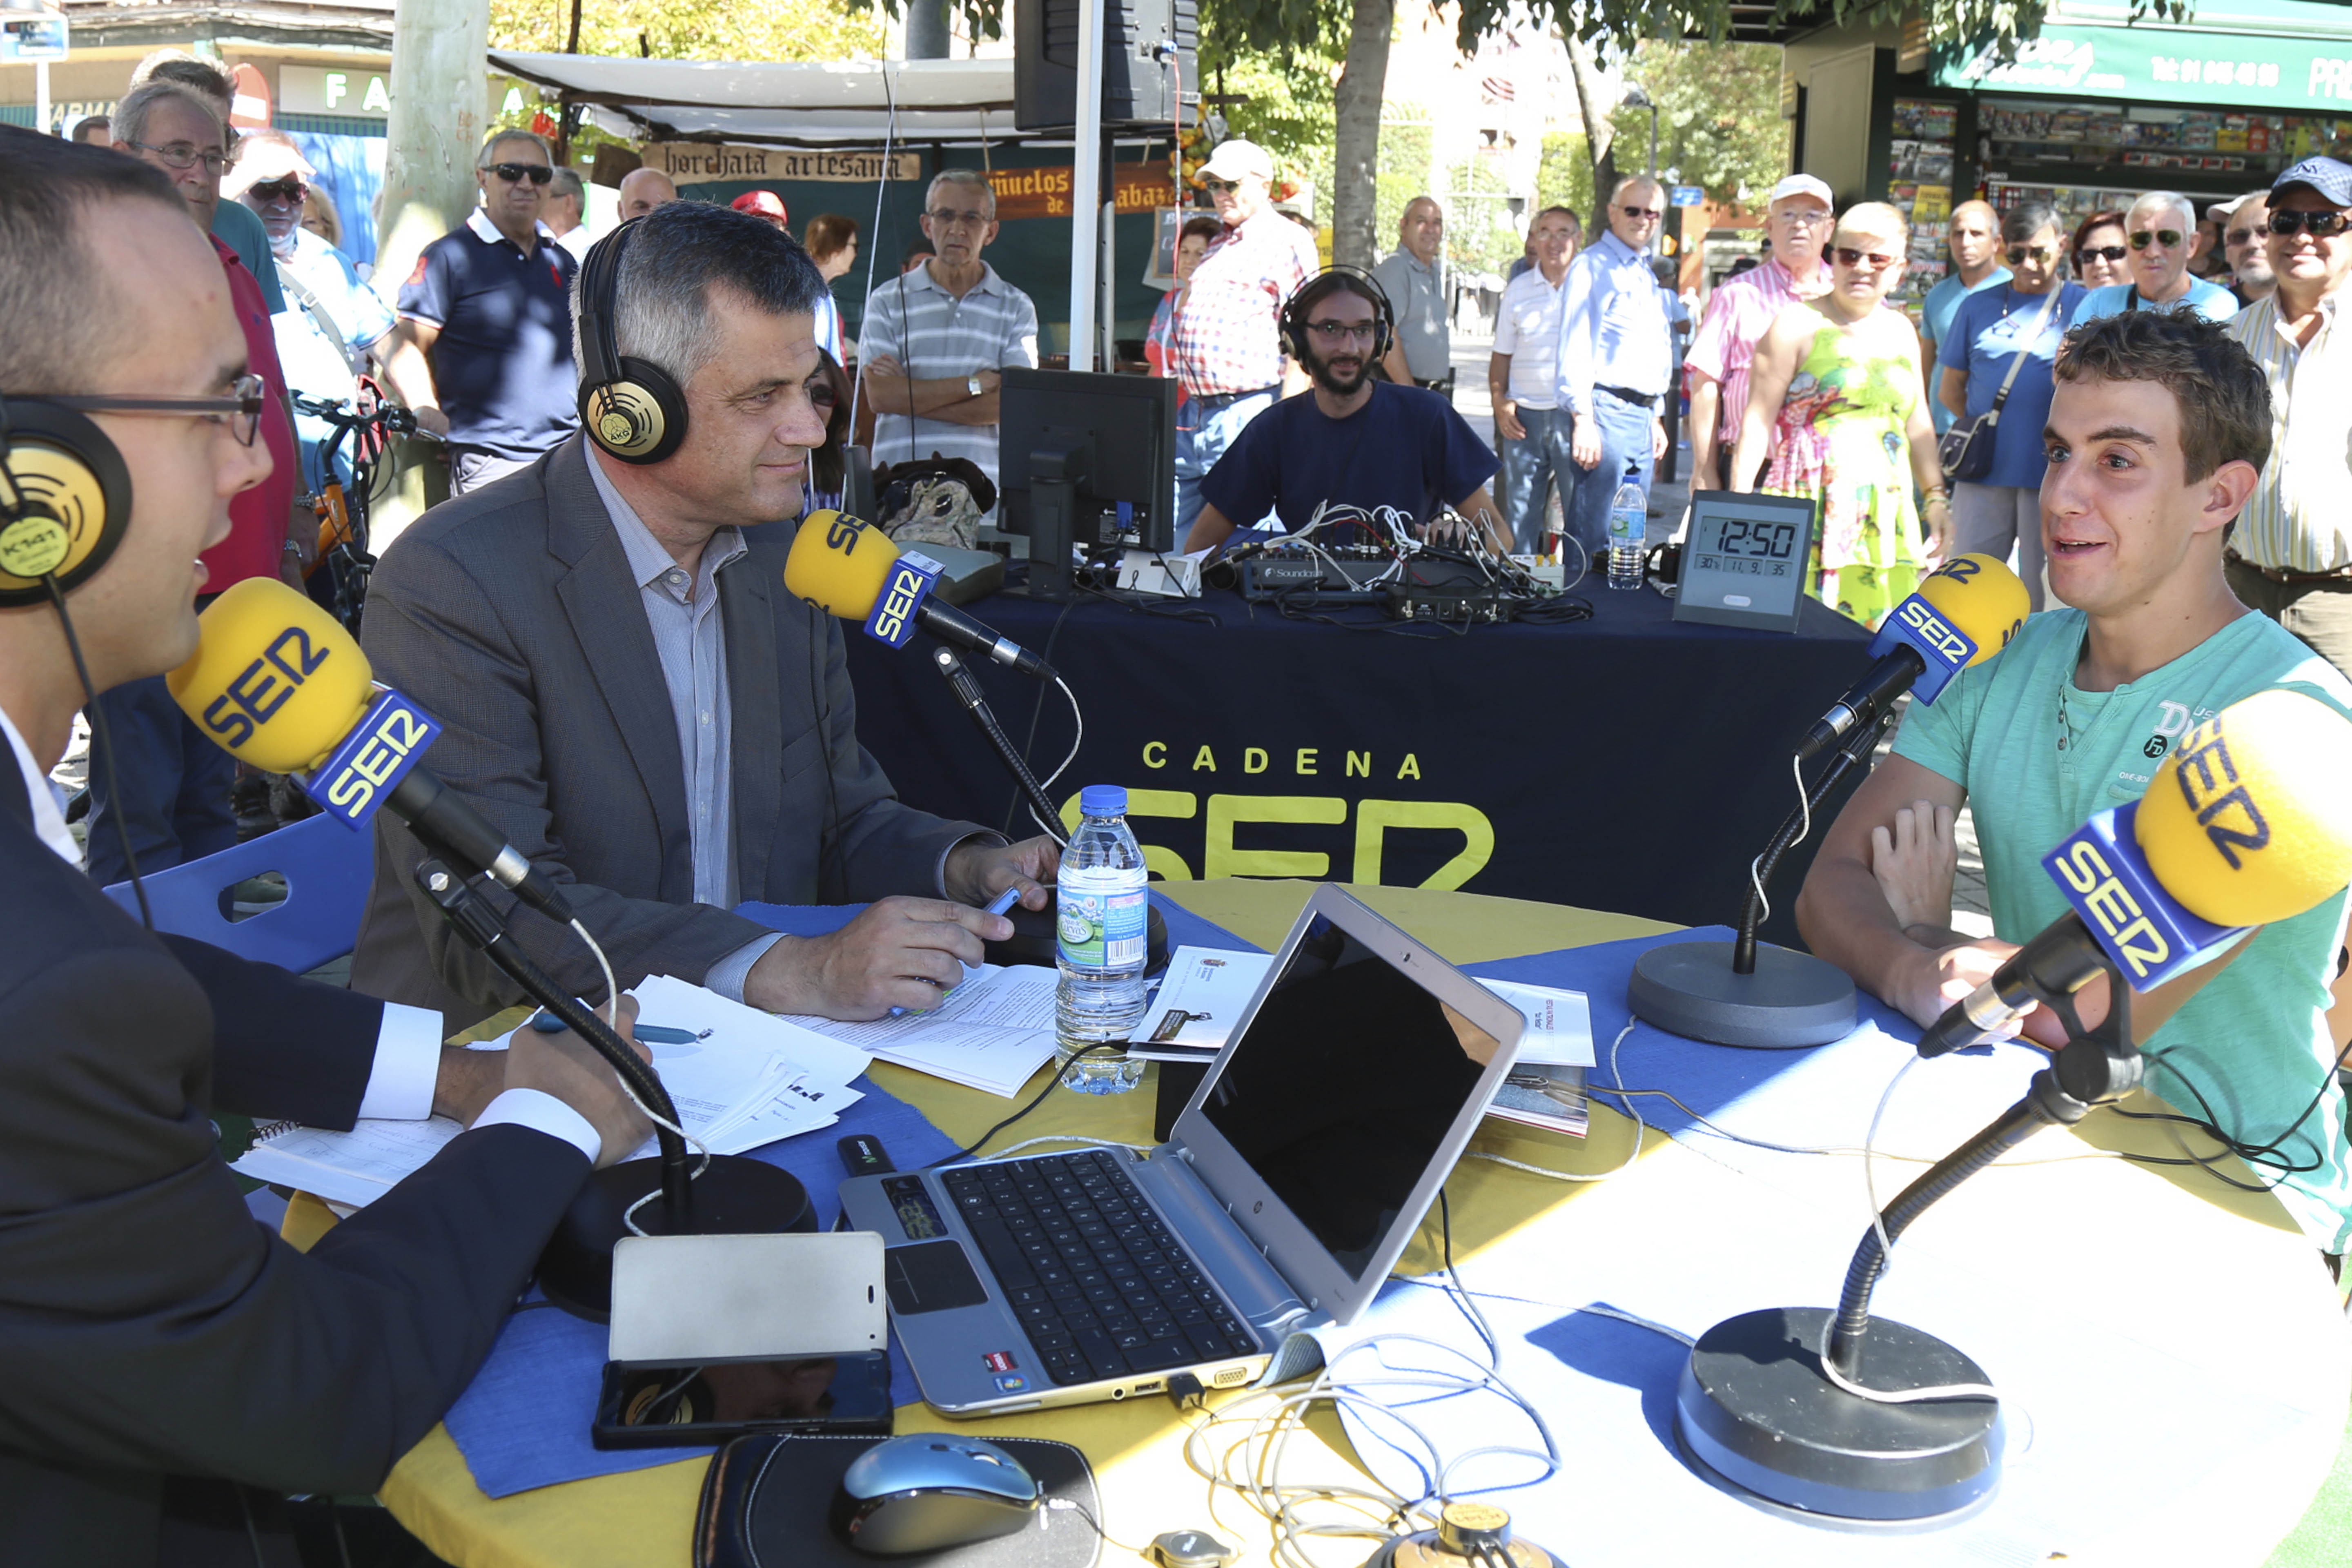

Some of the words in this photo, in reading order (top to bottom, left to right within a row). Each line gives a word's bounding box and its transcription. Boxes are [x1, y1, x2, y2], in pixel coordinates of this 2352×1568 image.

[664, 146, 767, 176] horchata
[1047, 195, 1064, 213] de
[611, 430, 630, 441] AKG
[1718, 521, 1795, 558] 12:50
[875, 570, 923, 642] SER
[1899, 601, 1968, 664] SER
[203, 627, 330, 748] SER
[328, 708, 428, 818] SER
[1143, 741, 1421, 780] CADENA
[2055, 840, 2169, 978] SER
